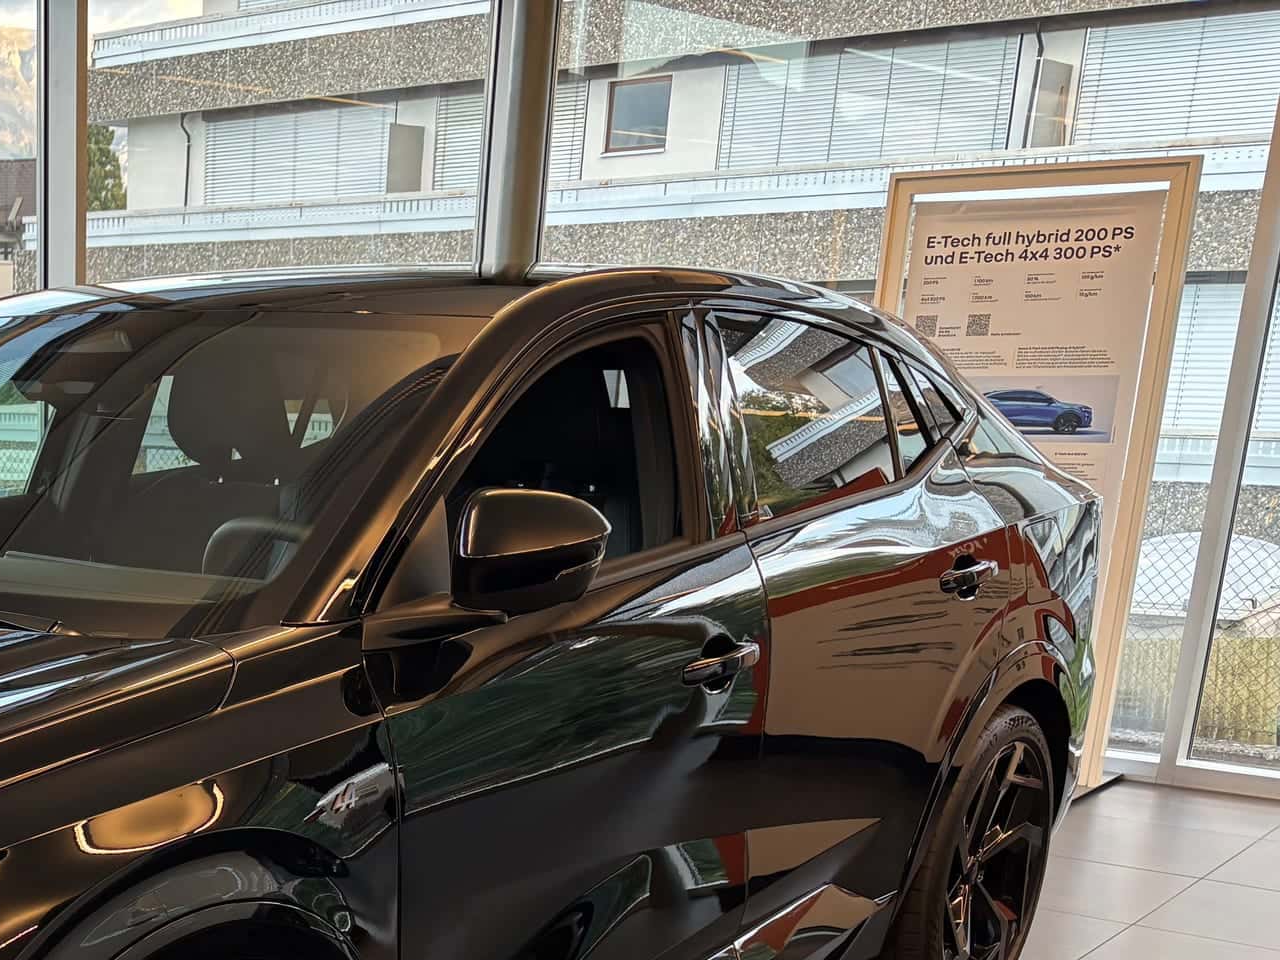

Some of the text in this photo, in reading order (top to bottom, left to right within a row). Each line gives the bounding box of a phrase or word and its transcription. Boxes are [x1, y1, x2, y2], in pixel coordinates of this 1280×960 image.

[926, 226, 1135, 249] E-Tech full hybrid 200 PS
[924, 251, 955, 266] und
[958, 248, 1015, 264] E-Tech
[1018, 247, 1050, 262] 4x4
[1053, 246, 1087, 260] 300
